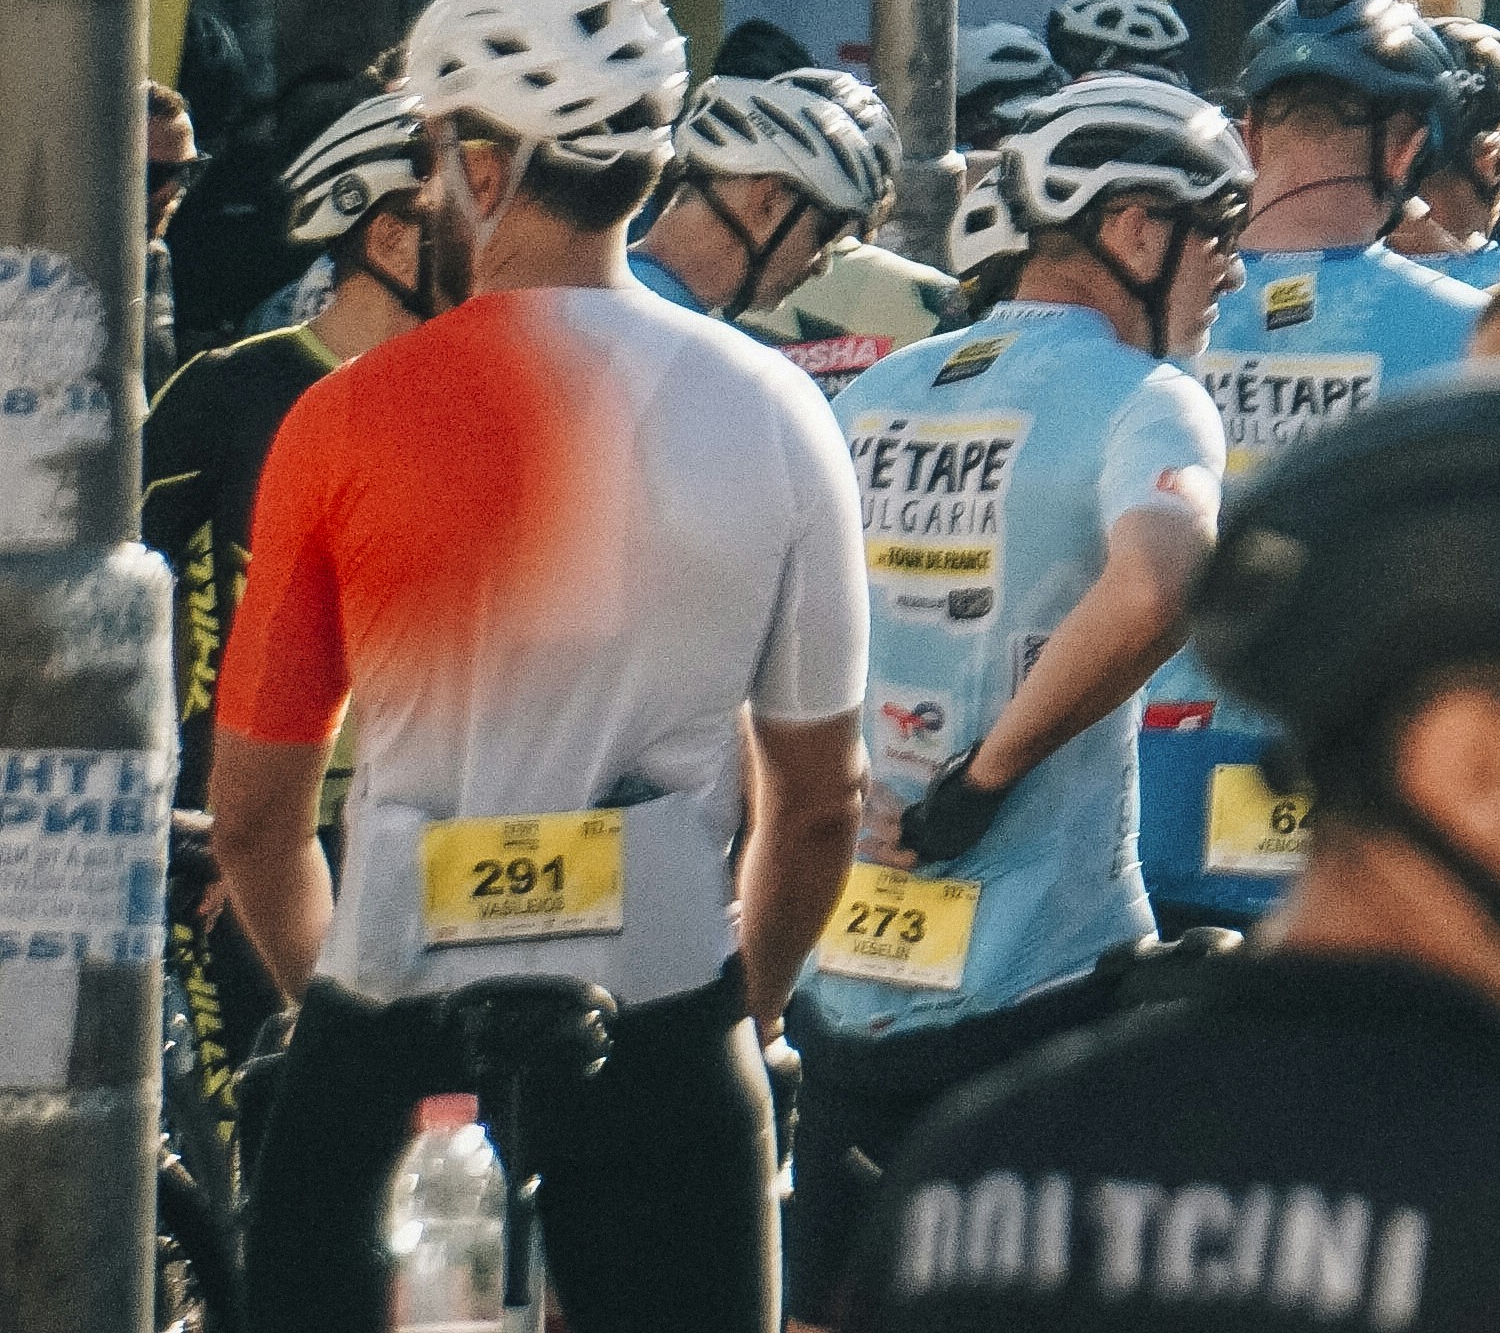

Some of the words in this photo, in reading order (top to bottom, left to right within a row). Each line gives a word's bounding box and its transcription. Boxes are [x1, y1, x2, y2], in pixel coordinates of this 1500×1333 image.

[860, 494, 998, 534] ULGARIA
[472, 854, 566, 898] 291
[846, 900, 927, 944] 273
